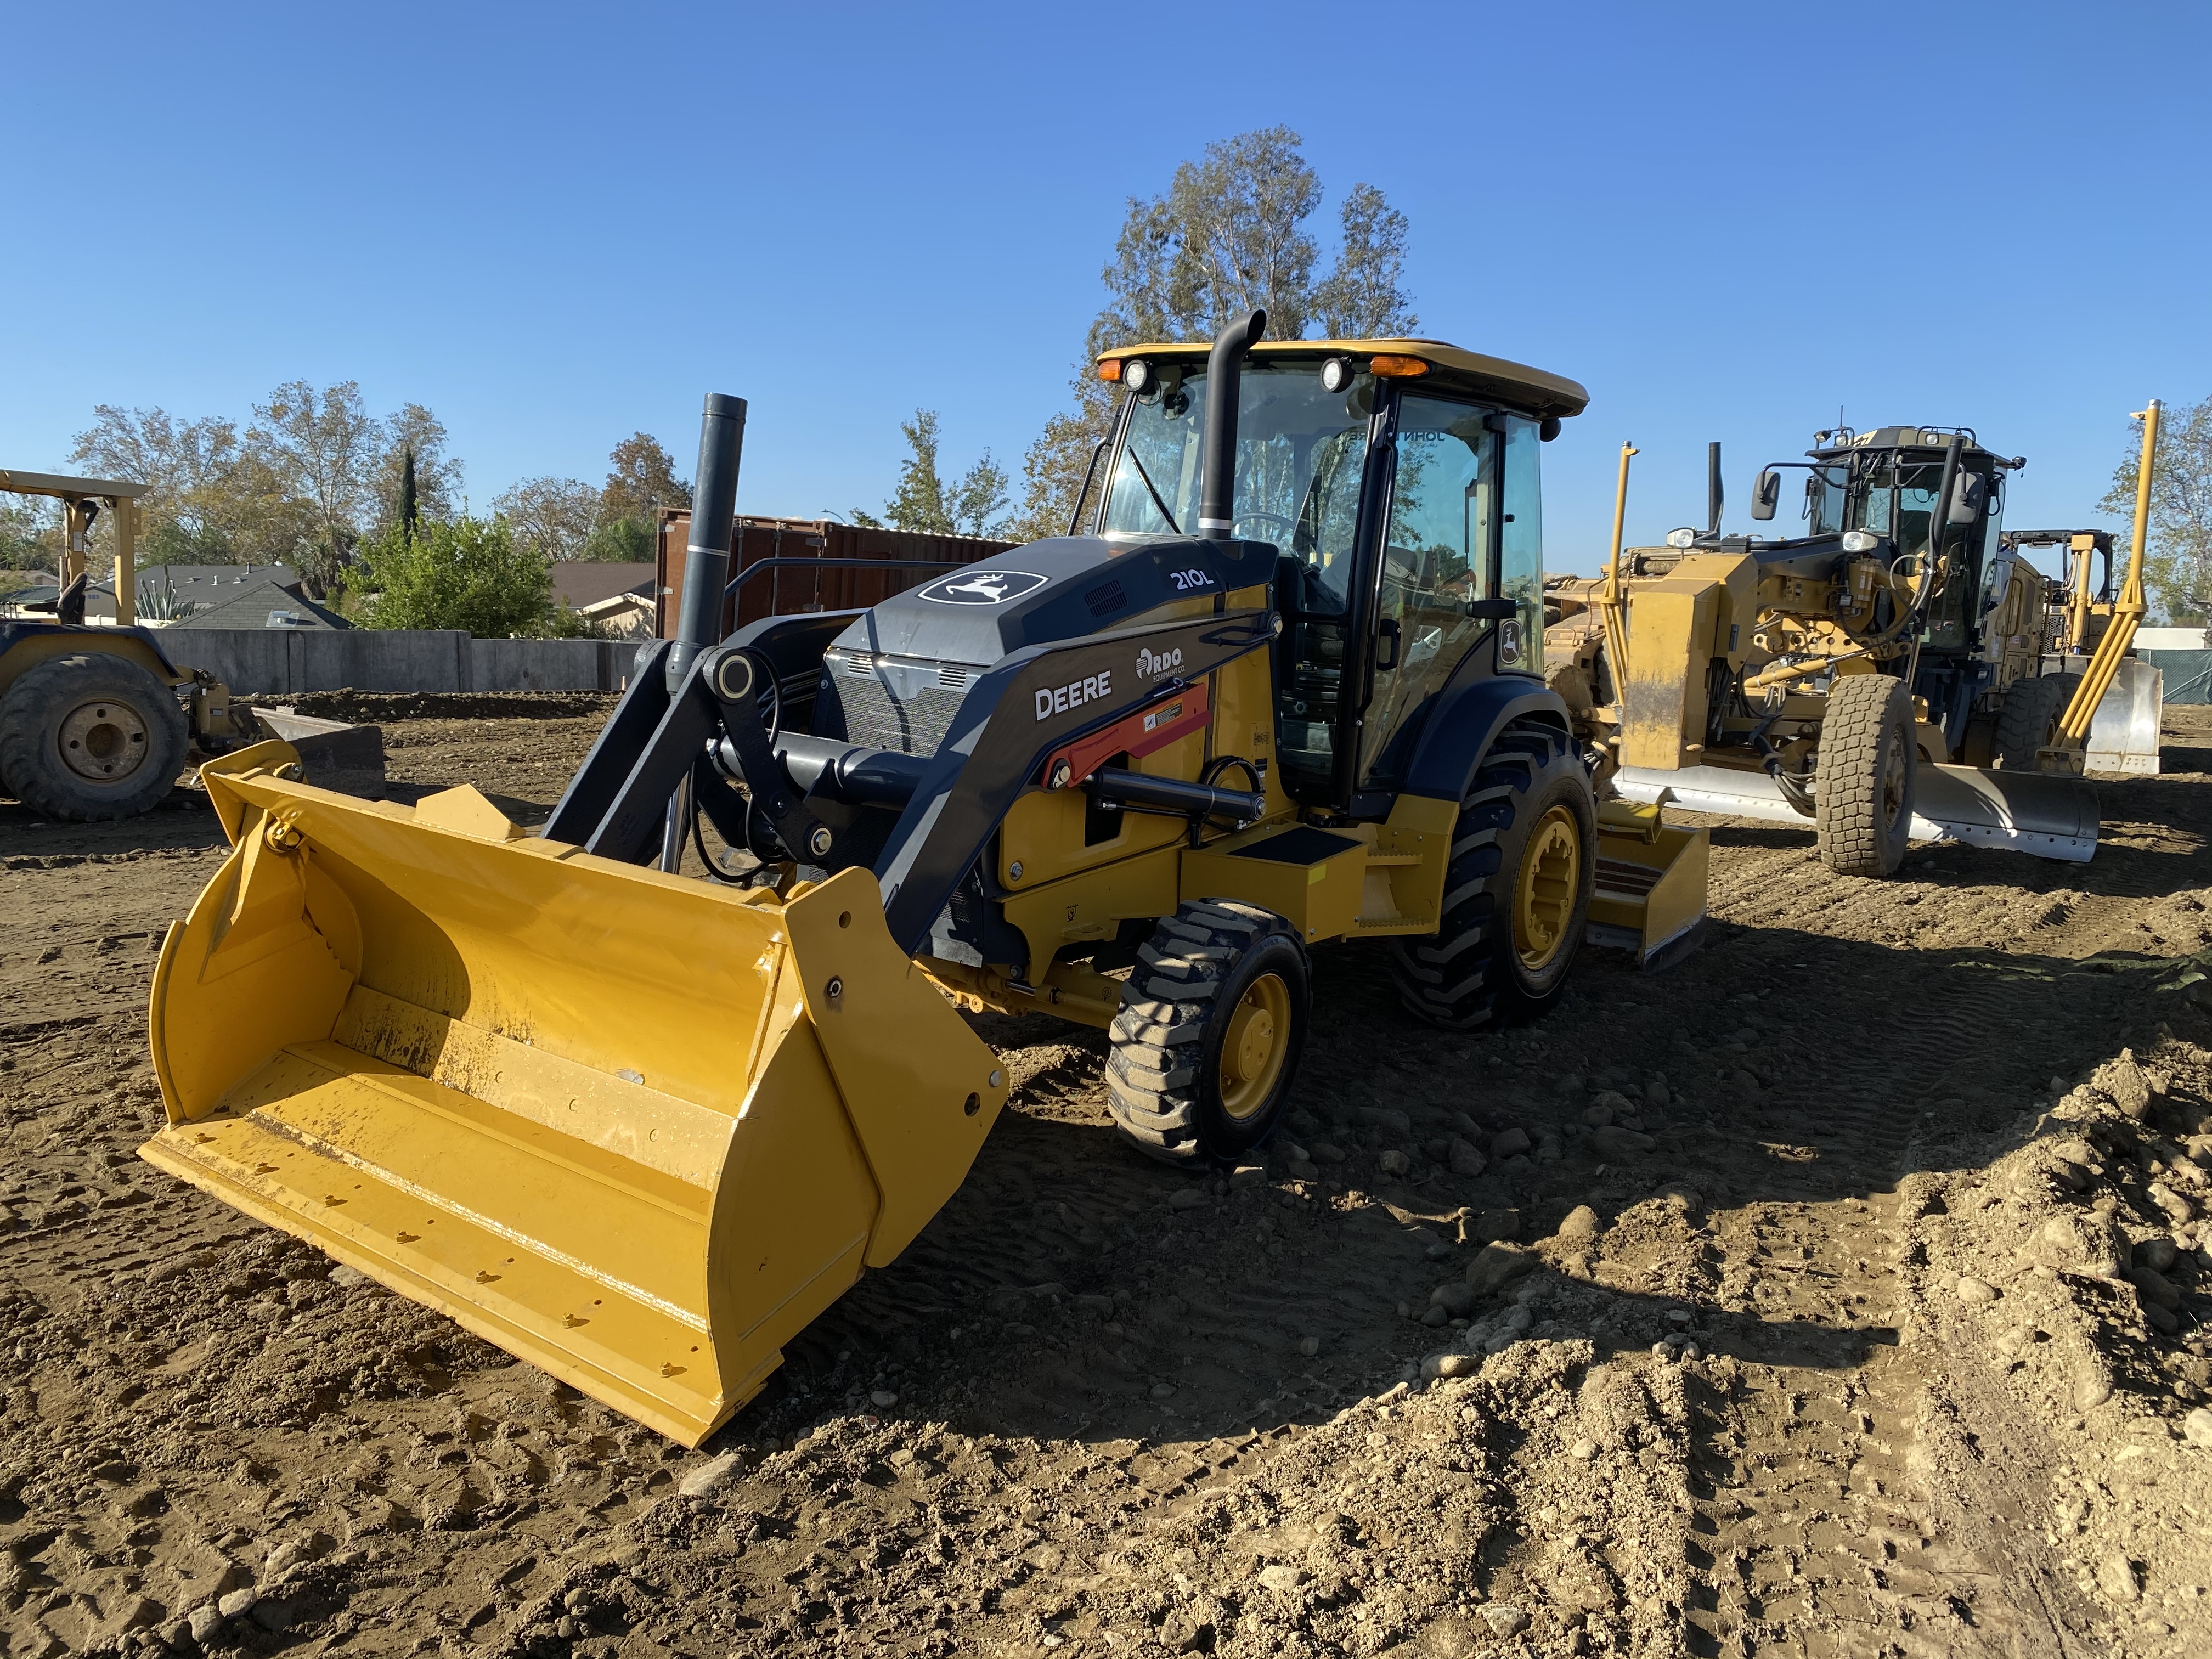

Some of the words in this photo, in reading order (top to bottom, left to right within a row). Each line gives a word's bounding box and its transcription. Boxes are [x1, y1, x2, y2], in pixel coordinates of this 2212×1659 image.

[1170, 569, 1214, 590] 210L
[1153, 668, 1177, 683] EQUIPMENT
[1035, 670, 1111, 720] DEERE
